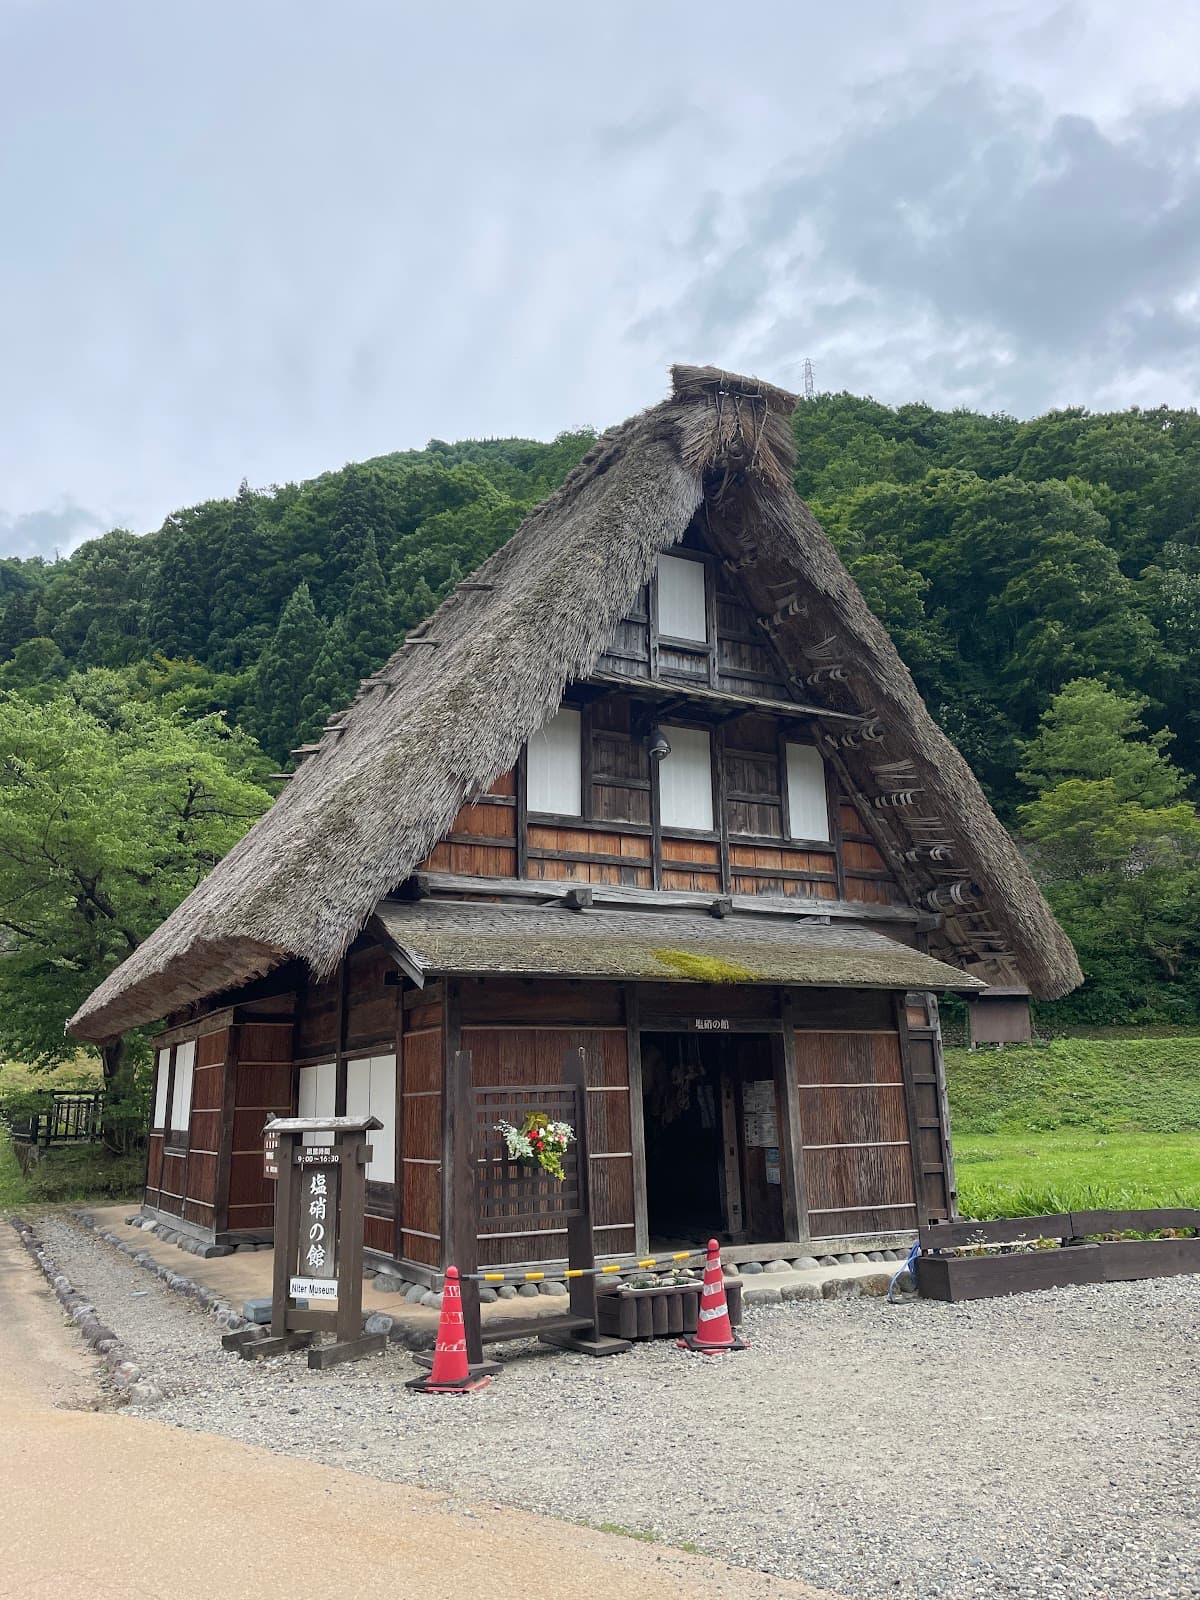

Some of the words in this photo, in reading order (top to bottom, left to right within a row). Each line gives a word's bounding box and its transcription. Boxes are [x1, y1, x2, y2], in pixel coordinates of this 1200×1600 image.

[306, 1173, 327, 1269] 塩硝の館
[291, 1283, 307, 1293] Niter
[309, 1284, 335, 1295] Museum
